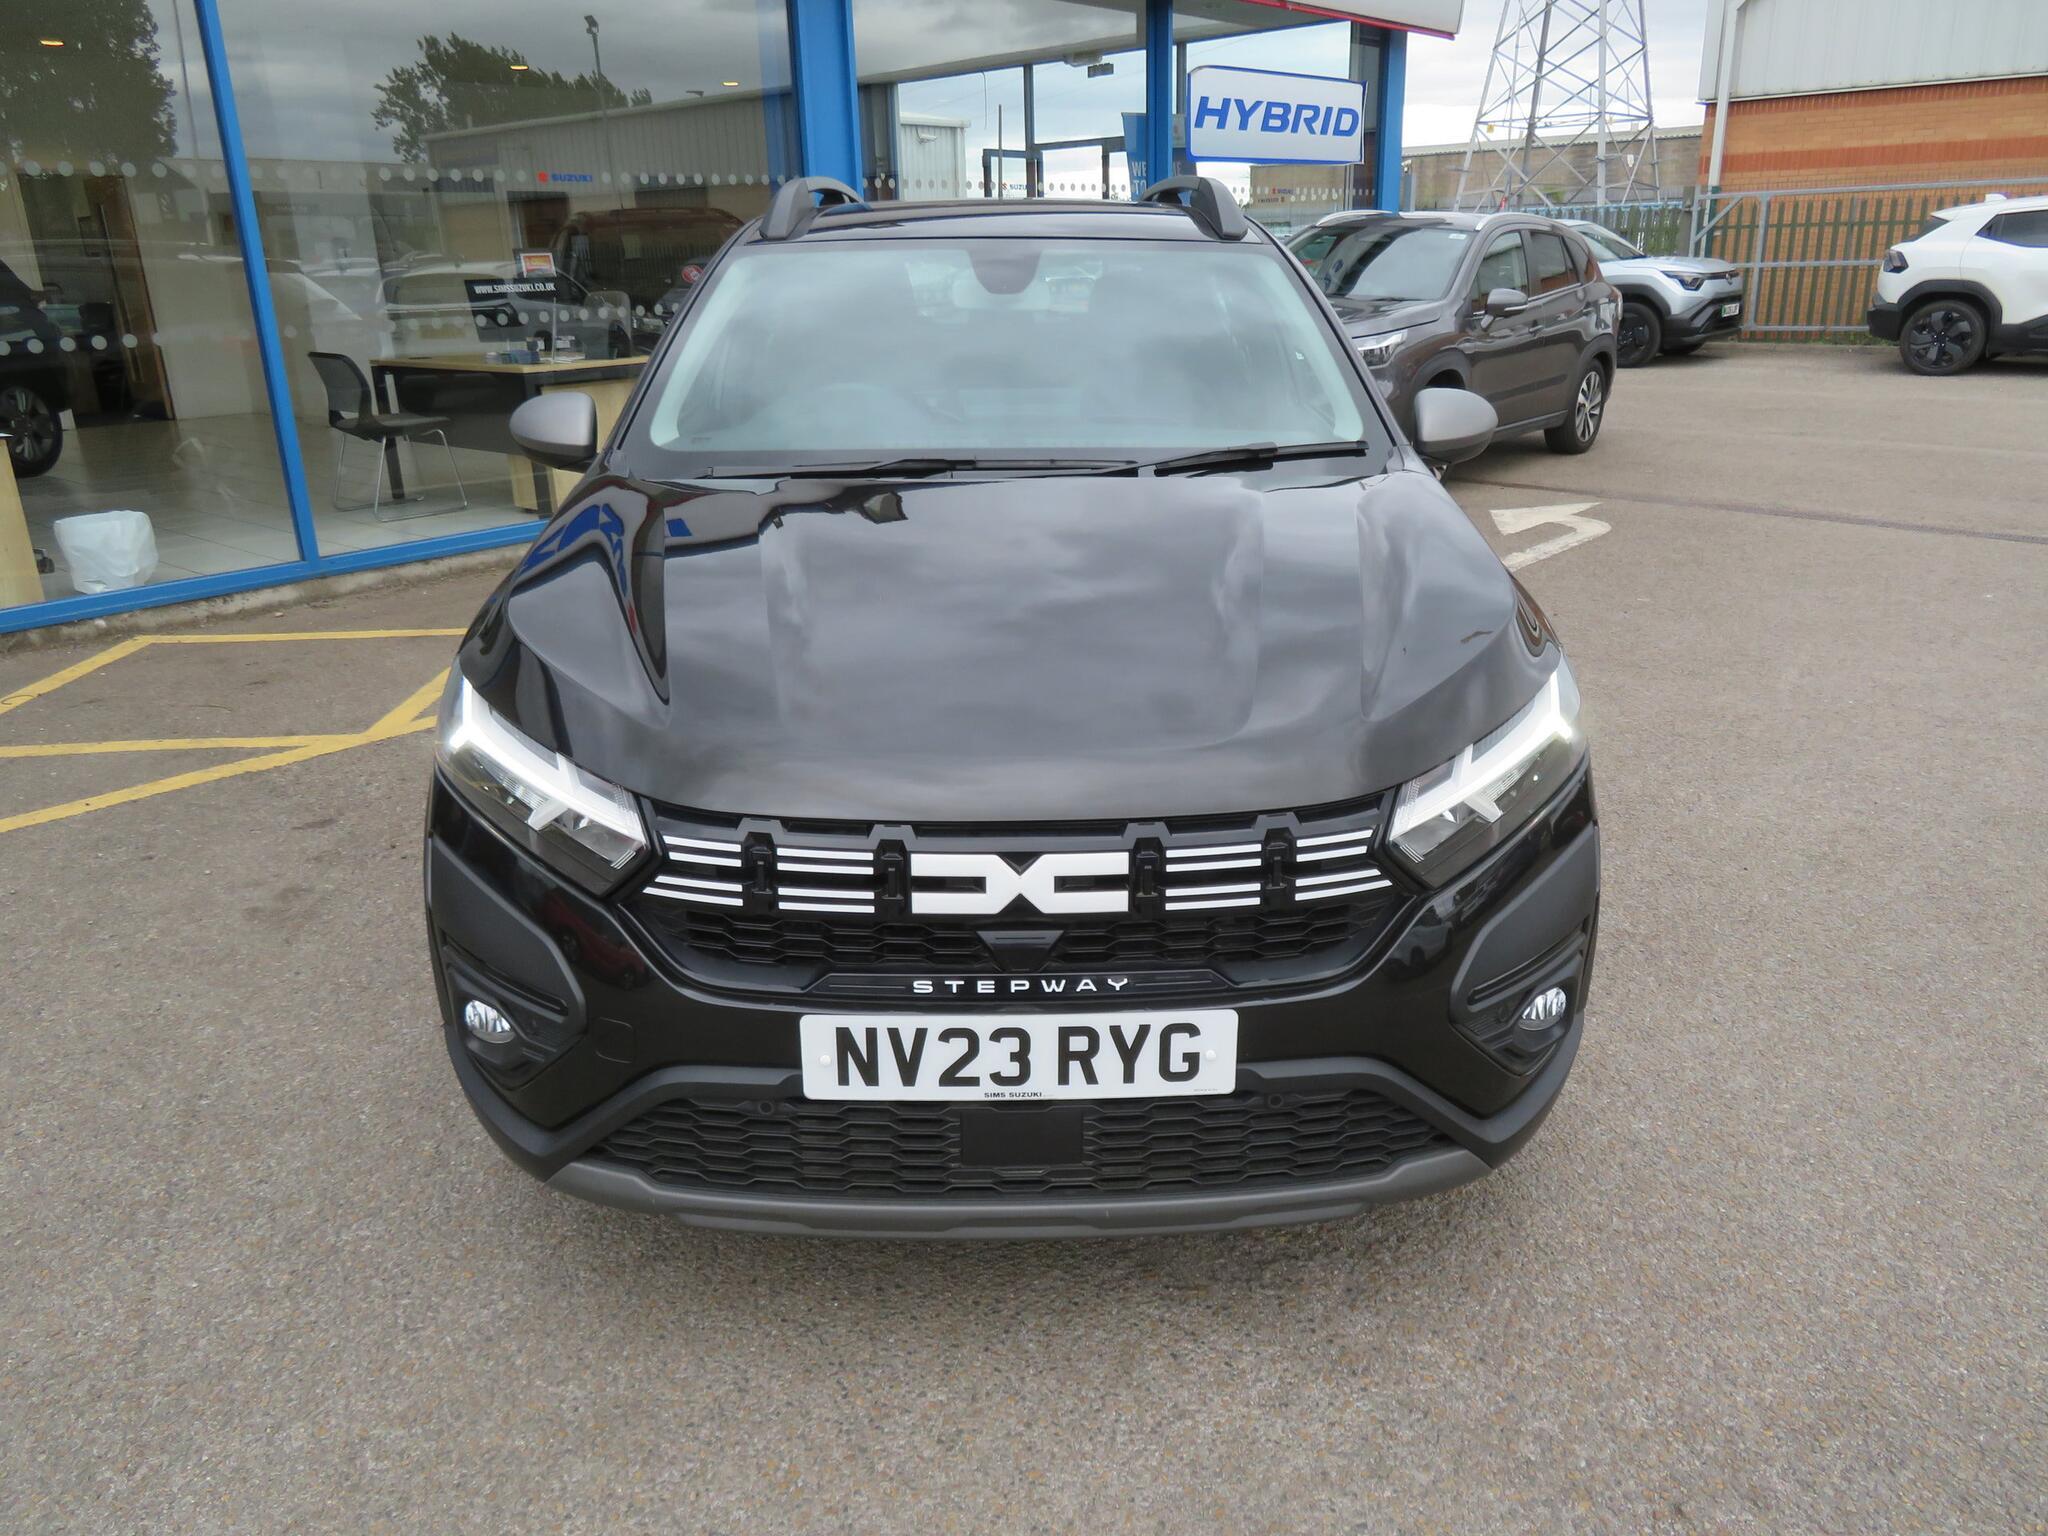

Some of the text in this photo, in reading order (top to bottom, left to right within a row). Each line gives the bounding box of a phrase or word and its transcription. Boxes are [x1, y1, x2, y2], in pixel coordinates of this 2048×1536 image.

[1194, 96, 1359, 137] HYBRID
[912, 977, 1129, 994] STEPWAY
[835, 1022, 1201, 1088] NV23 RYG
